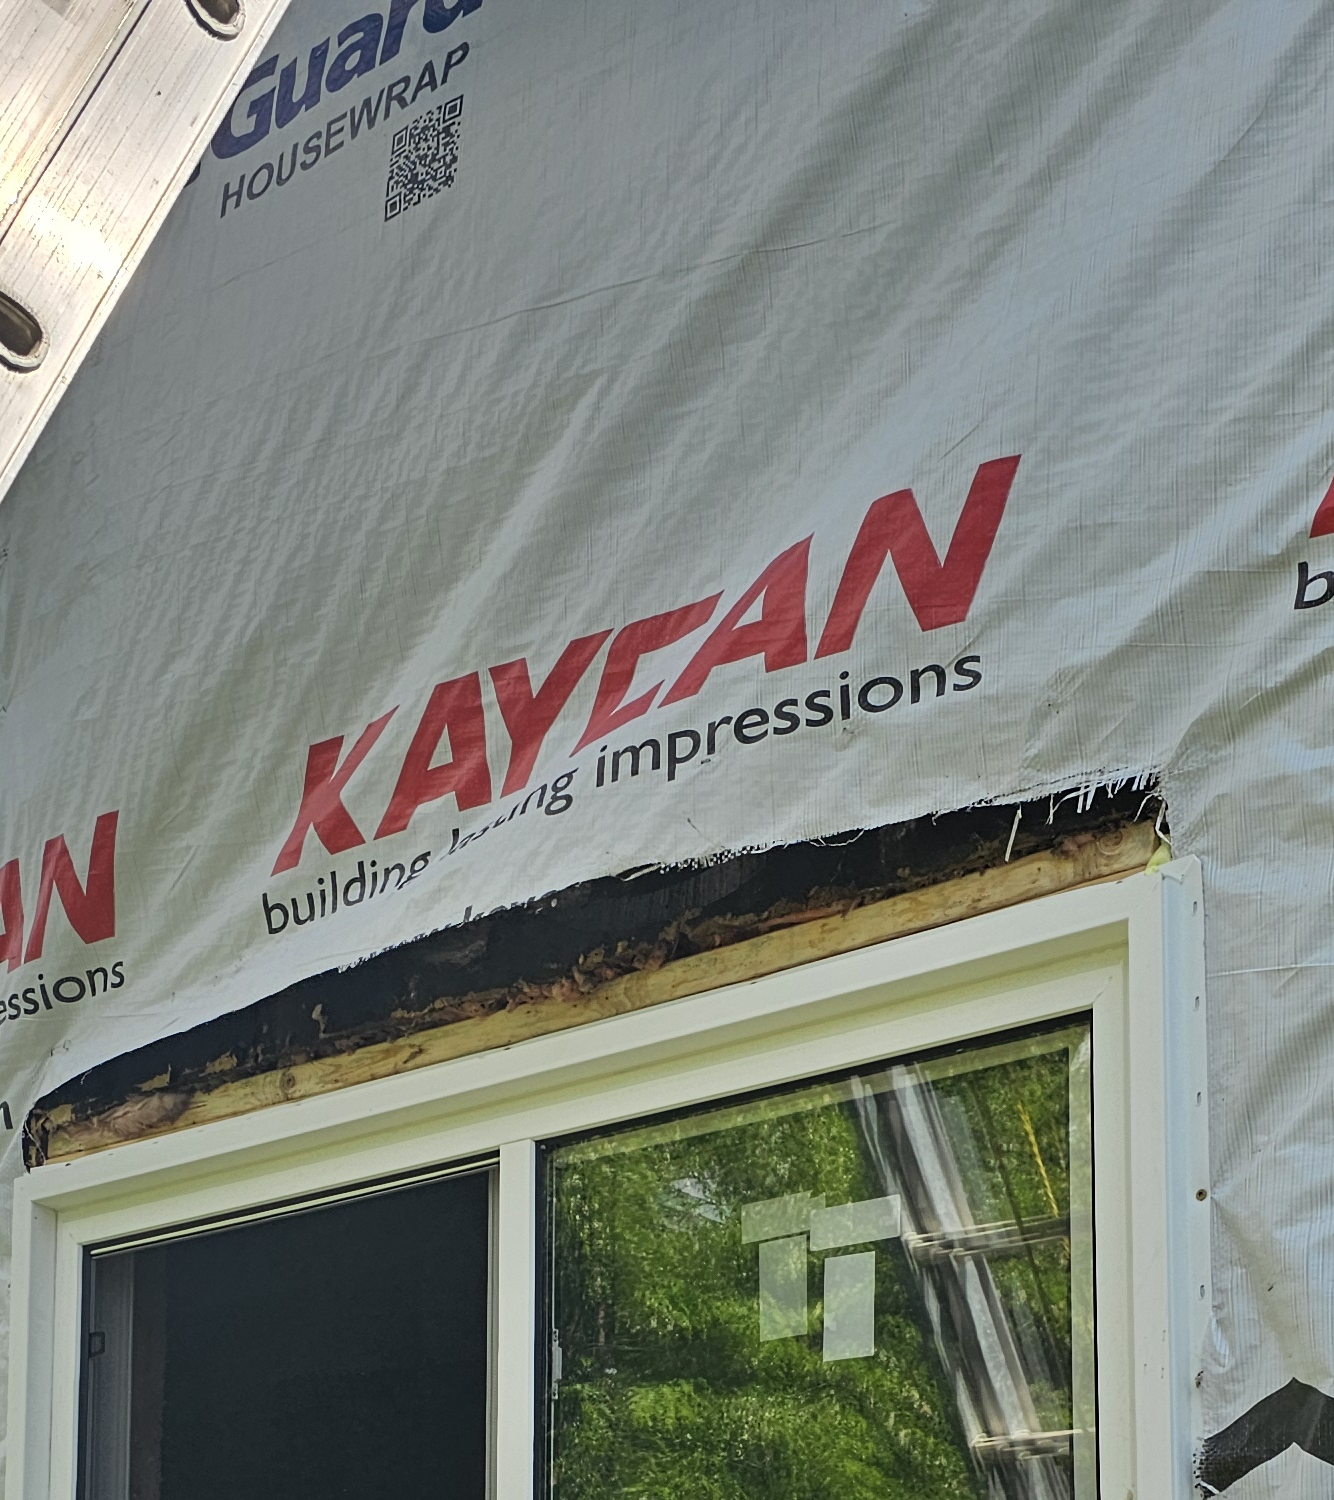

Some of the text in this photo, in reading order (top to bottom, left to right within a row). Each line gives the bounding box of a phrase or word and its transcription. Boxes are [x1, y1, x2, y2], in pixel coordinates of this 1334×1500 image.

[220, 41, 470, 219] HOUSEWRAP
[271, 454, 1023, 877] KAYCAN
[595, 653, 983, 789] impressions
